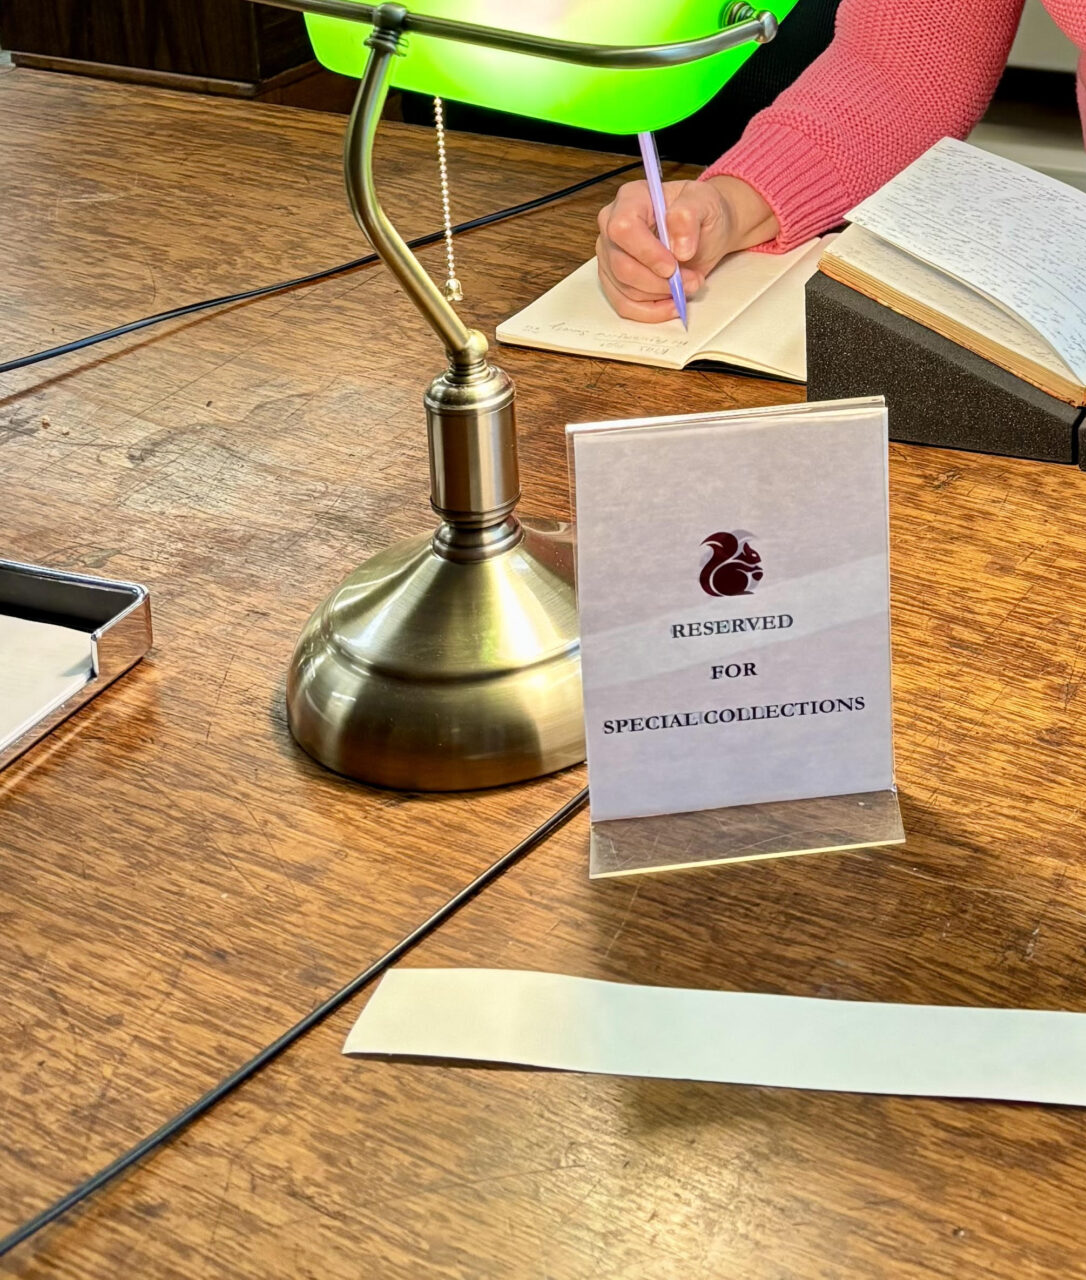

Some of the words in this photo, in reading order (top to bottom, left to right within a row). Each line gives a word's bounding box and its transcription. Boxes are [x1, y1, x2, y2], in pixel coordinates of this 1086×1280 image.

[672, 614, 794, 639] RESERVED
[711, 662, 758, 680] FOR
[603, 712, 699, 734] SPECIAL
[703, 696, 866, 724] COLLECTIONS
